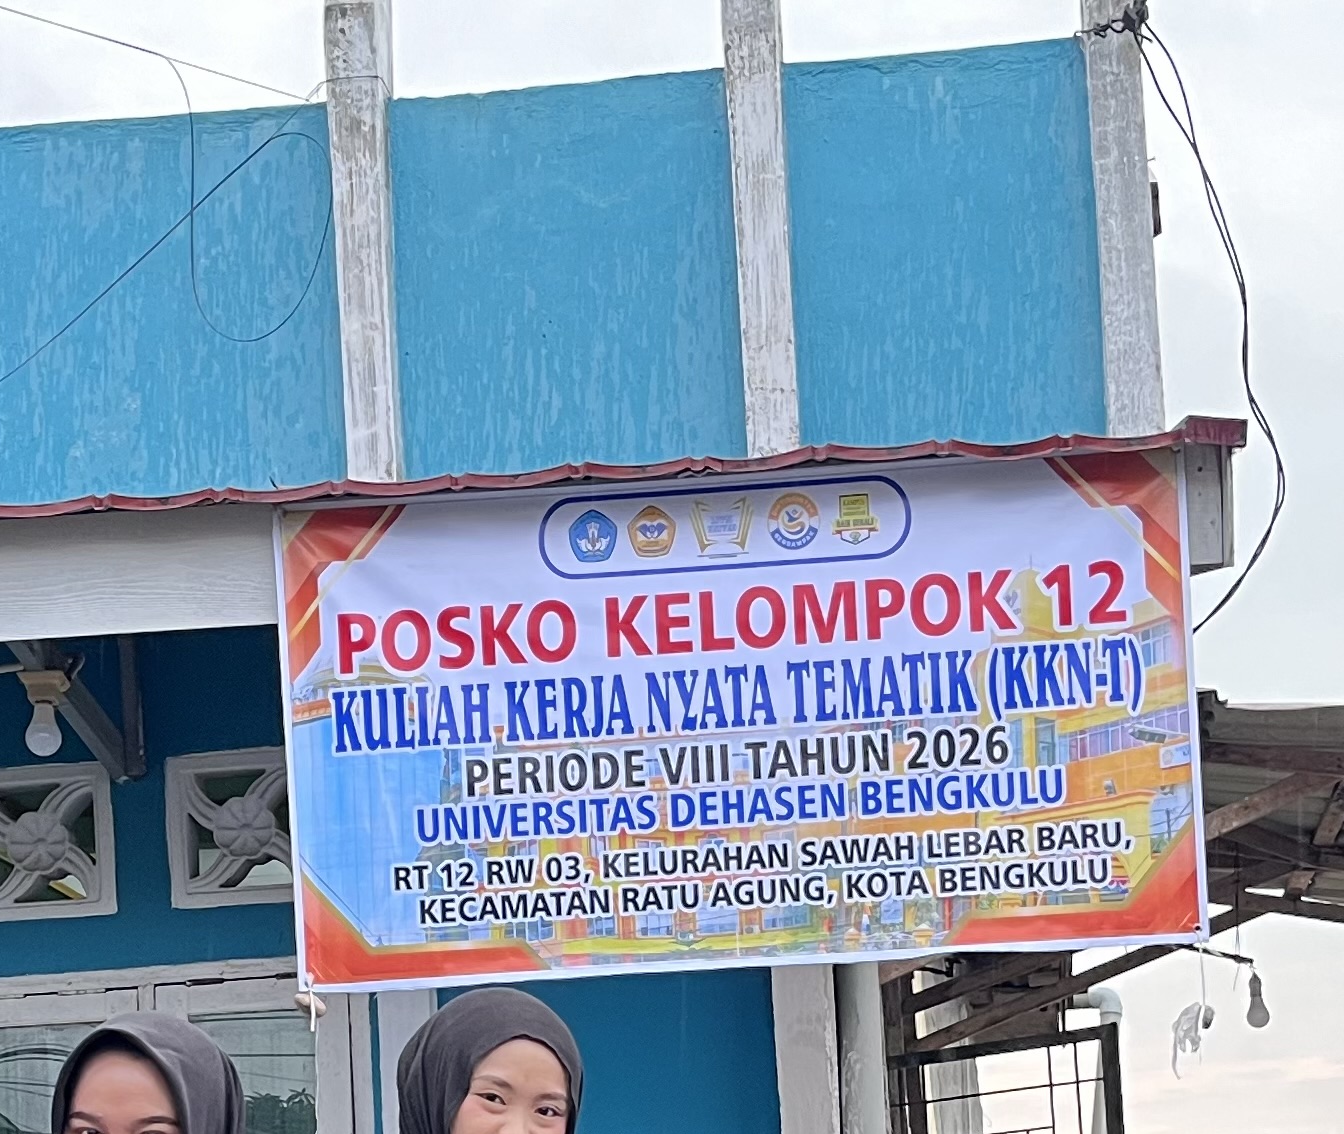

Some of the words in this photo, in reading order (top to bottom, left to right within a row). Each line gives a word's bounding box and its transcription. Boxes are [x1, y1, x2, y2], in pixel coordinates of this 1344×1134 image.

[336, 599, 577, 675] POSKO
[604, 568, 1018, 658] KELOMPOK
[1041, 559, 1128, 627] 12
[331, 682, 492, 753] KULIAH
[503, 673, 635, 741] KERJA
[644, 662, 778, 732] NYATA
[786, 649, 977, 724] TEMATIK
[989, 636, 1142, 721] (KKN-T)
[464, 749, 646, 798] PERIODE
[658, 742, 731, 785] VIII
[744, 731, 890, 780] TAHUN
[906, 725, 1009, 771] 2026
[416, 794, 657, 843] UNIVERSITAS
[671, 782, 846, 827] DEHASEN
[860, 768, 1063, 814] BENGKULU
[393, 864, 429, 891] RT
[440, 862, 475, 888] 12
[486, 858, 534, 886] RW
[545, 856, 591, 884] 03,
[603, 843, 789, 879] KELURAHAN
[801, 835, 915, 867] SAWAH
[926, 828, 1026, 858] LEBAR
[1037, 821, 1132, 852] BARU,
[419, 888, 611, 924] KECAMATAN
[622, 884, 701, 913] RATU
[709, 875, 835, 907] AGUNG,
[846, 870, 929, 900] KOTA
[939, 858, 1109, 894] BENGKULU
